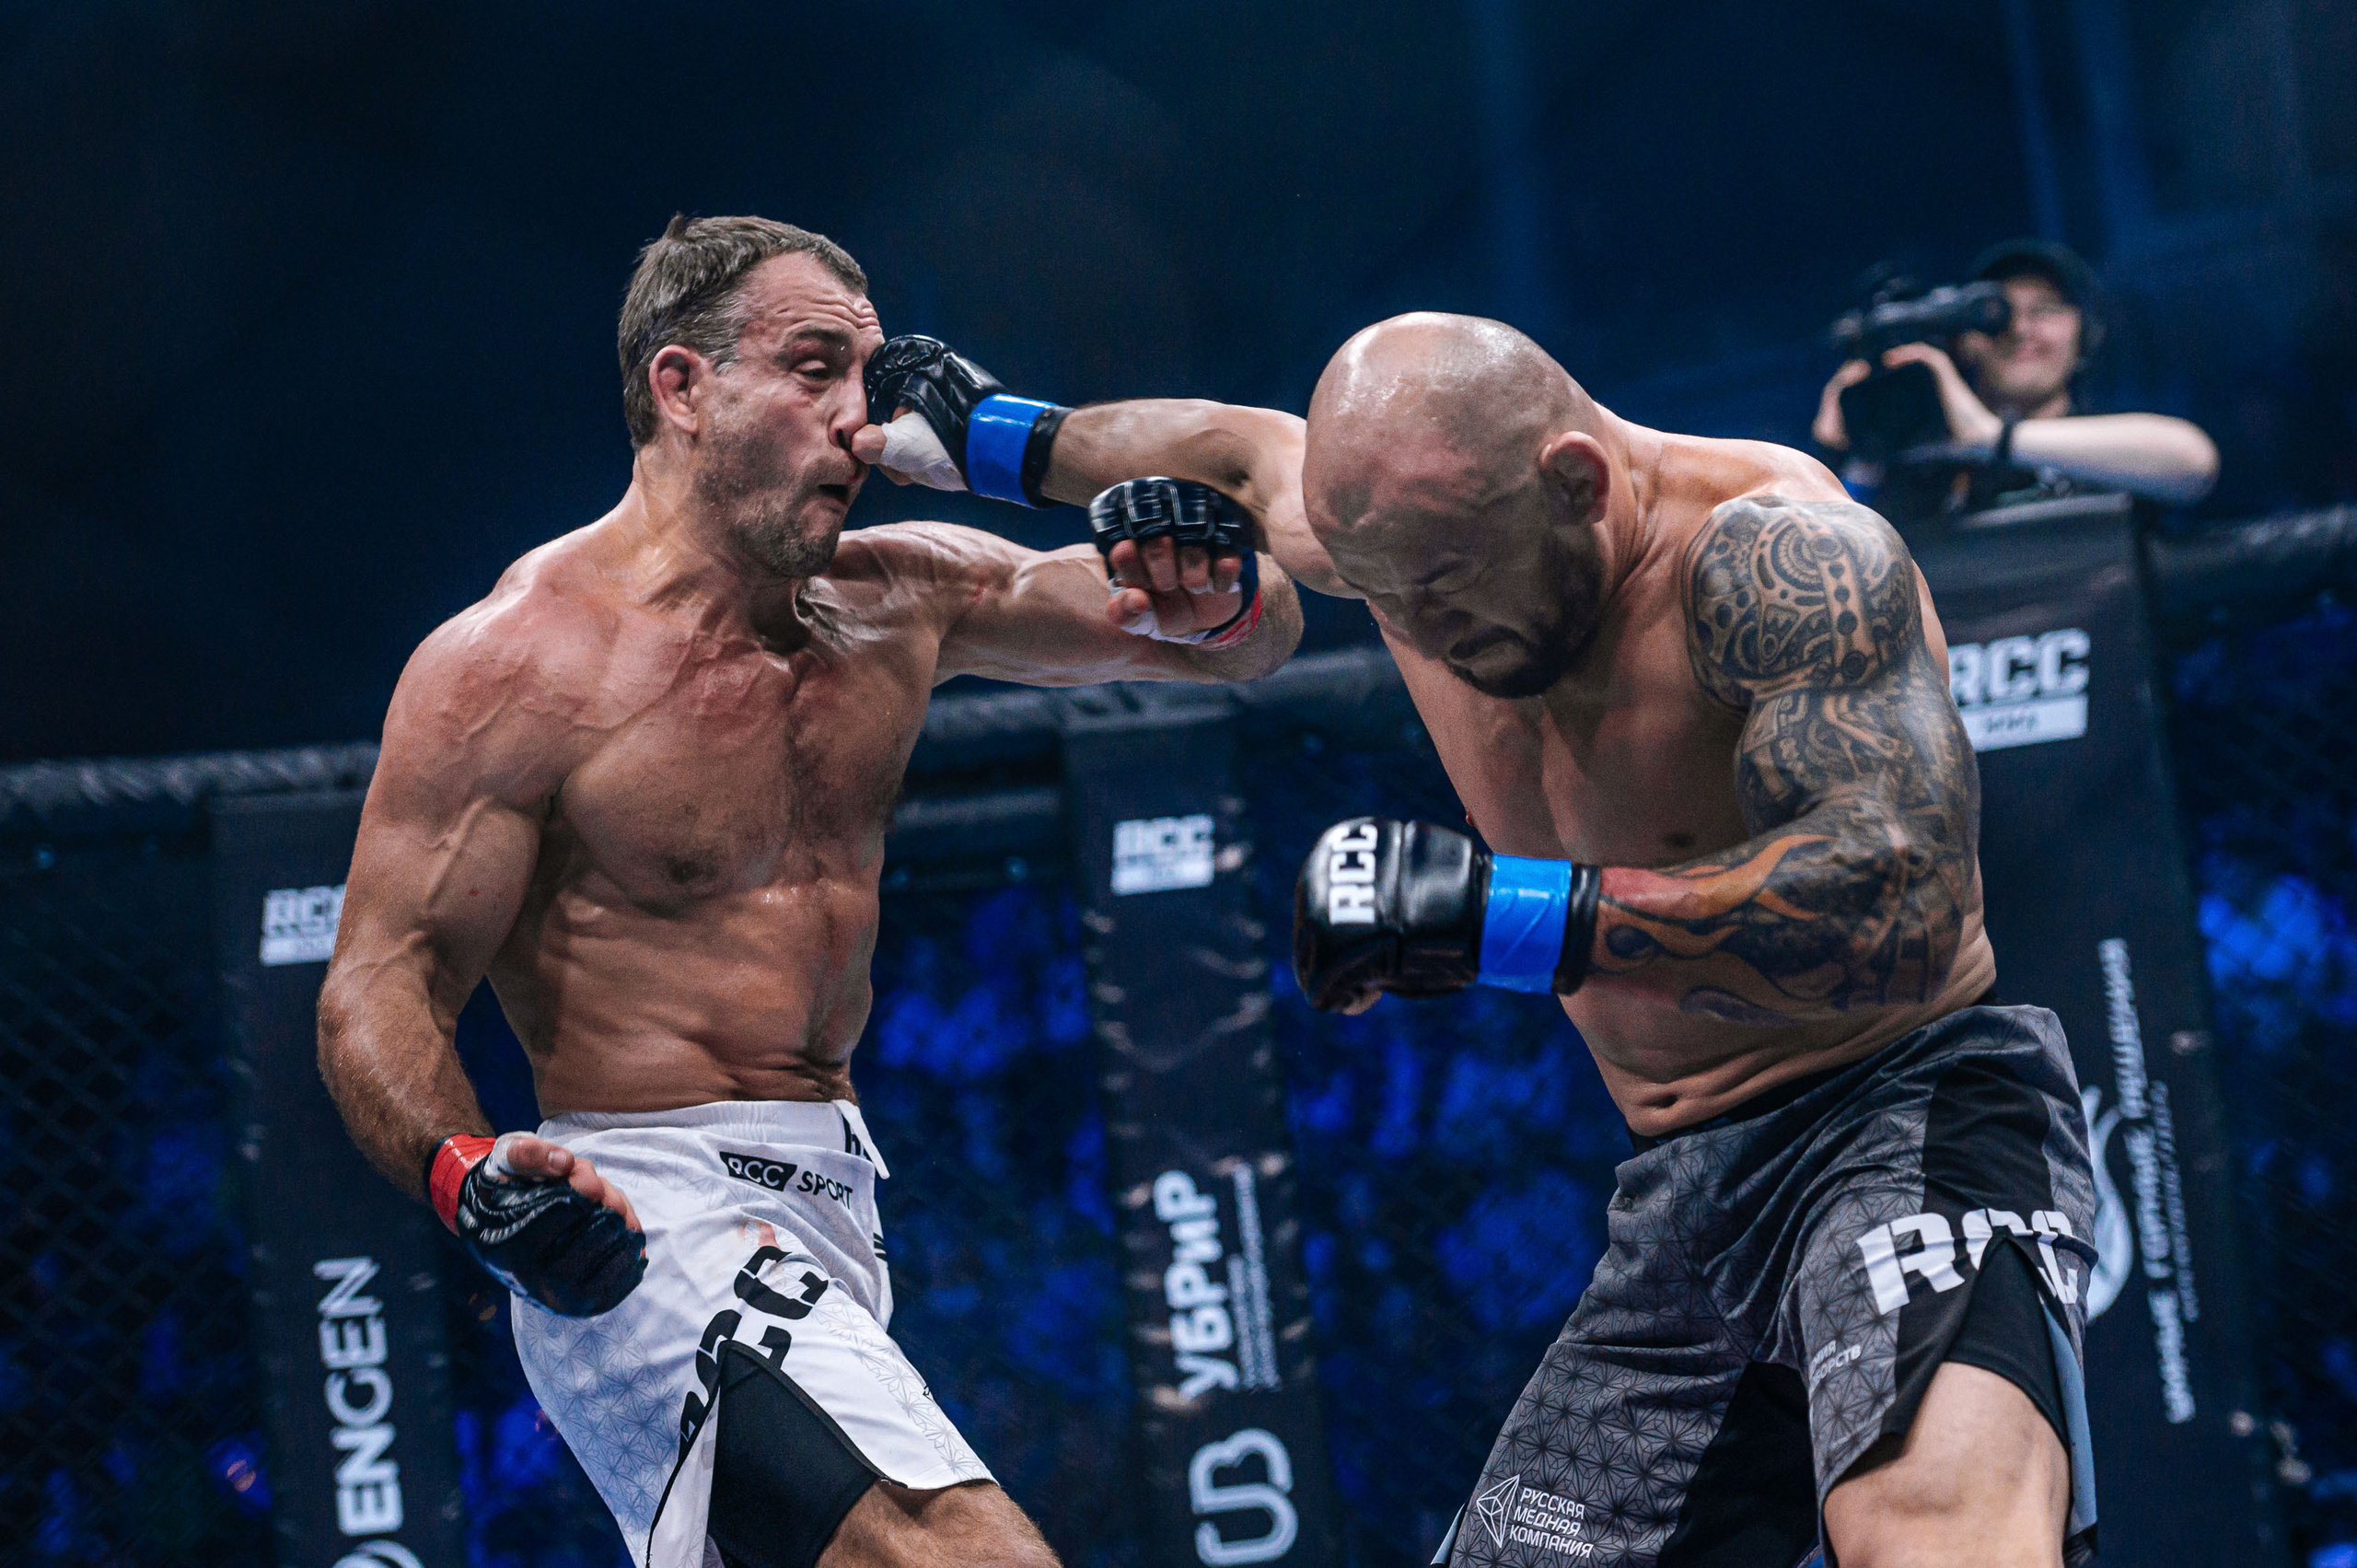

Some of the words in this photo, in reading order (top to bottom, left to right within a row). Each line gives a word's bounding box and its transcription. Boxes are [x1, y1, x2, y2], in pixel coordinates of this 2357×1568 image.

[1947, 628, 2091, 708] RCC
[1329, 822, 1378, 925] RCC
[727, 1157, 784, 1187] RCC
[796, 1170, 853, 1210] SPORT
[313, 1256, 405, 1537] ENGEN
[1513, 1505, 1581, 1537] МЕДНАЯ
[1519, 1487, 1585, 1520] РУССКАЯ
[1509, 1524, 1595, 1559] КОМПАНИЯ
